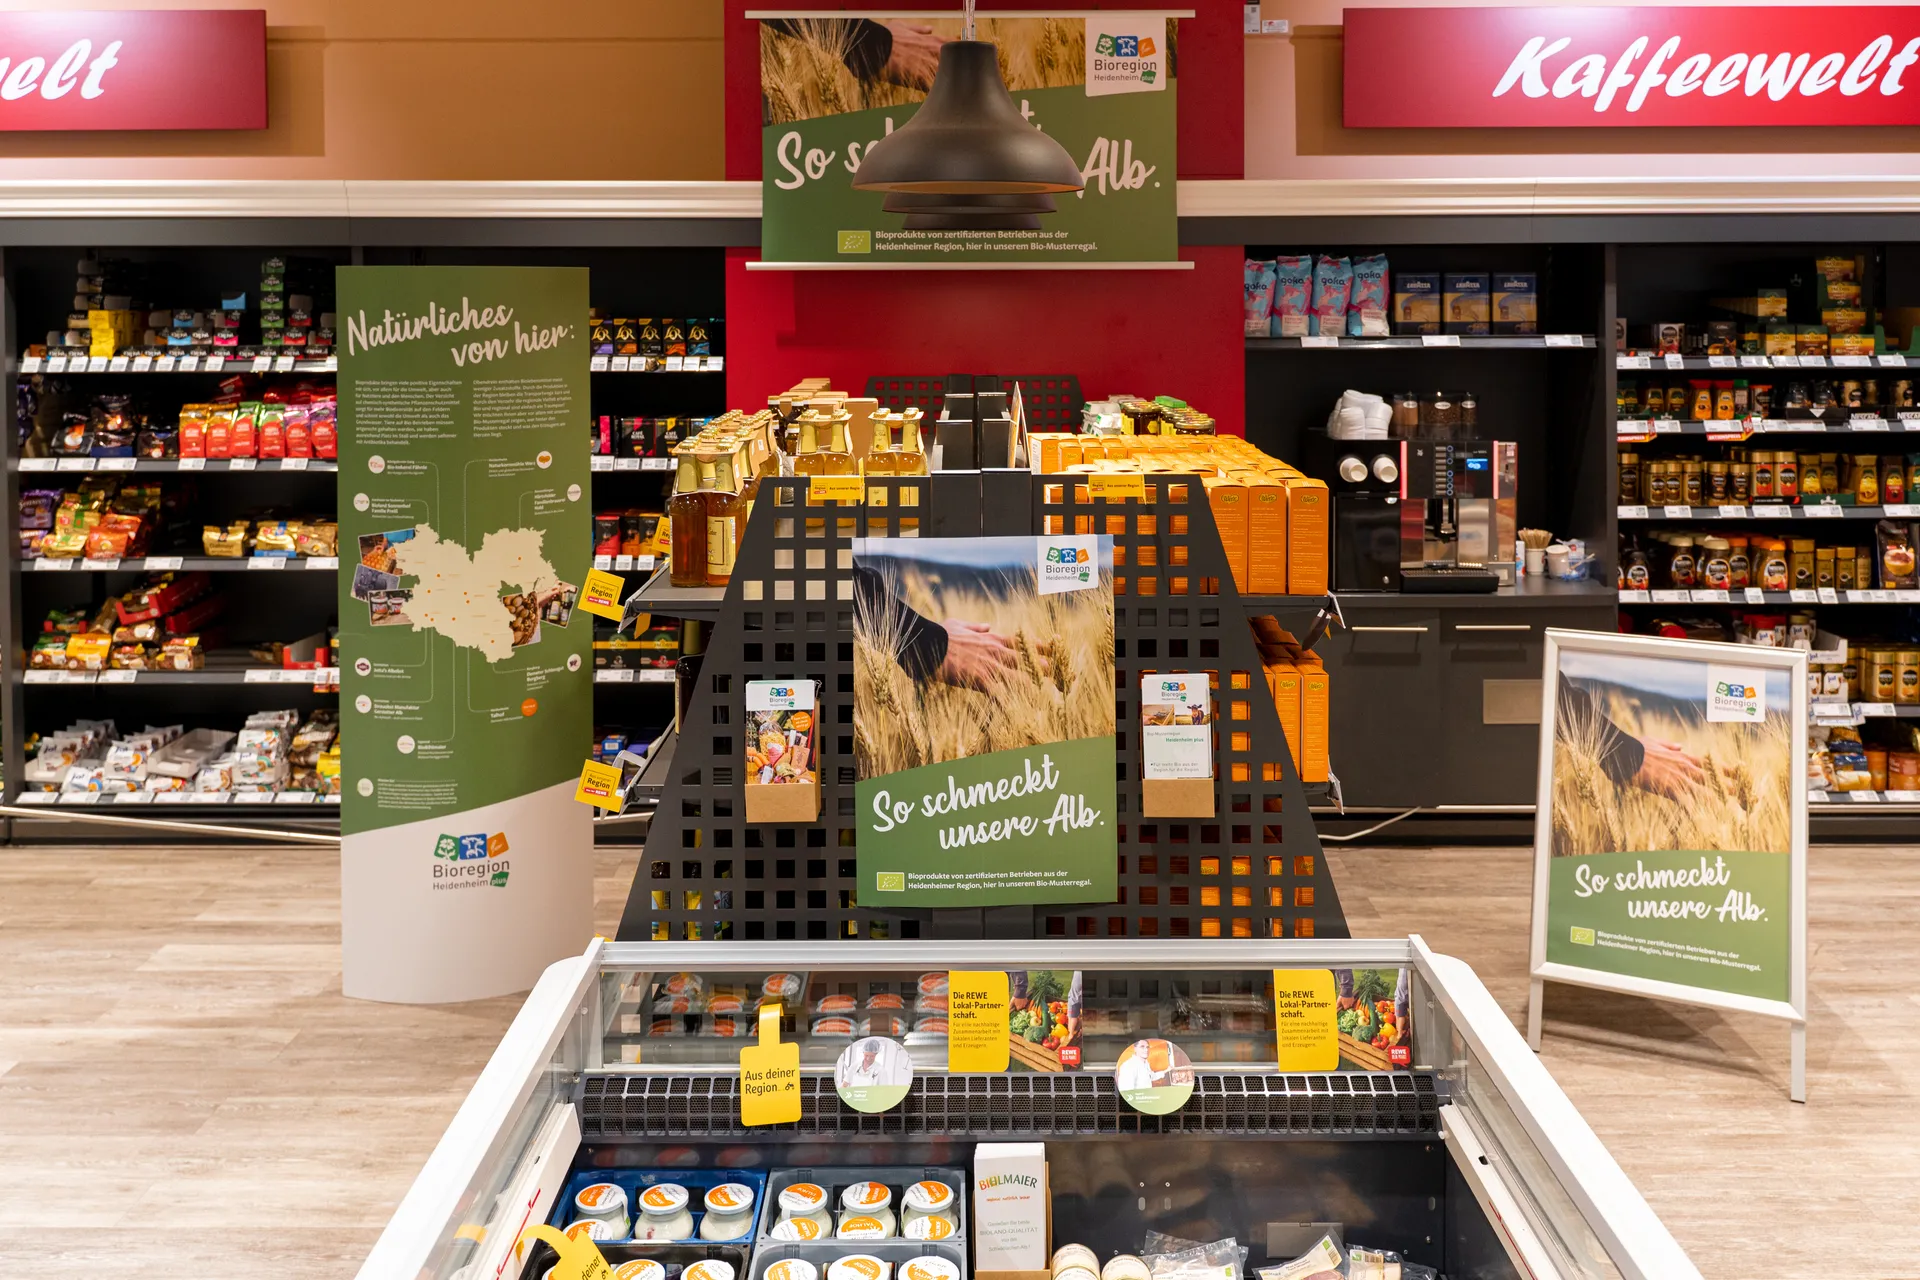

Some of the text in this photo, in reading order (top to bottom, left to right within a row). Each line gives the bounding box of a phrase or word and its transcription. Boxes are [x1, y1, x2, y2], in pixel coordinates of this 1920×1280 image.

[1094, 58, 1157, 73] Bioregion
[1094, 73, 1140, 82] Heidenheim
[1492, 34, 1920, 113] Kaffeewelt
[774, 131, 836, 190] So
[875, 230, 924, 240] Bioprodukte
[944, 230, 996, 239] zertifizierten
[998, 230, 1036, 238] Betrieben
[1054, 230, 1068, 238] der
[875, 242, 931, 250] Heidenheimer
[934, 242, 964, 253] Region,
[966, 242, 981, 250] hier
[984, 242, 992, 250] in
[1031, 242, 1098, 252] Bio-Musterregal.
[1280, 276, 1304, 286] goka
[1321, 276, 1345, 286] goka
[1357, 270, 1381, 281] goka
[1406, 281, 1431, 289] LAVAZZA
[1456, 281, 1480, 289] LAVAZZA
[1504, 280, 1528, 288] LAVAZZA
[346, 296, 514, 356] Natürliches
[450, 321, 575, 368] von hier:
[1045, 564, 1090, 575] Bioregion
[591, 587, 613, 598] Region
[1714, 696, 1758, 709] Bioregion
[587, 778, 610, 788] Region
[872, 753, 1060, 832] So schmeckt
[939, 792, 1105, 850] unsere Alb.
[433, 860, 510, 878] Bioregion
[908, 872, 950, 880] Bioprodukte
[1574, 856, 1730, 898] So schmeckt
[433, 877, 507, 890] Heidenheim plus
[957, 881, 982, 890] Region,
[1036, 879, 1092, 888] Bio-Musterregal.
[1628, 890, 1769, 923] unsere Alb.
[1597, 930, 1633, 942] Bioprodukte
[1647, 938, 1685, 950] zertifizierten
[1686, 944, 1716, 954] Betrieben
[1597, 939, 1638, 953] Heidenheimer
[1638, 946, 1661, 957] Region,
[1662, 950, 1674, 958] hier
[1682, 955, 1709, 963] unserem
[1710, 958, 1761, 972] Bio-Musterregal.
[1280, 1000, 1331, 1008] Lokal-Partner-
[953, 1011, 977, 1019] schaft.
[1281, 1010, 1305, 1019] schaft.
[745, 1068, 796, 1081] Aus deiner
